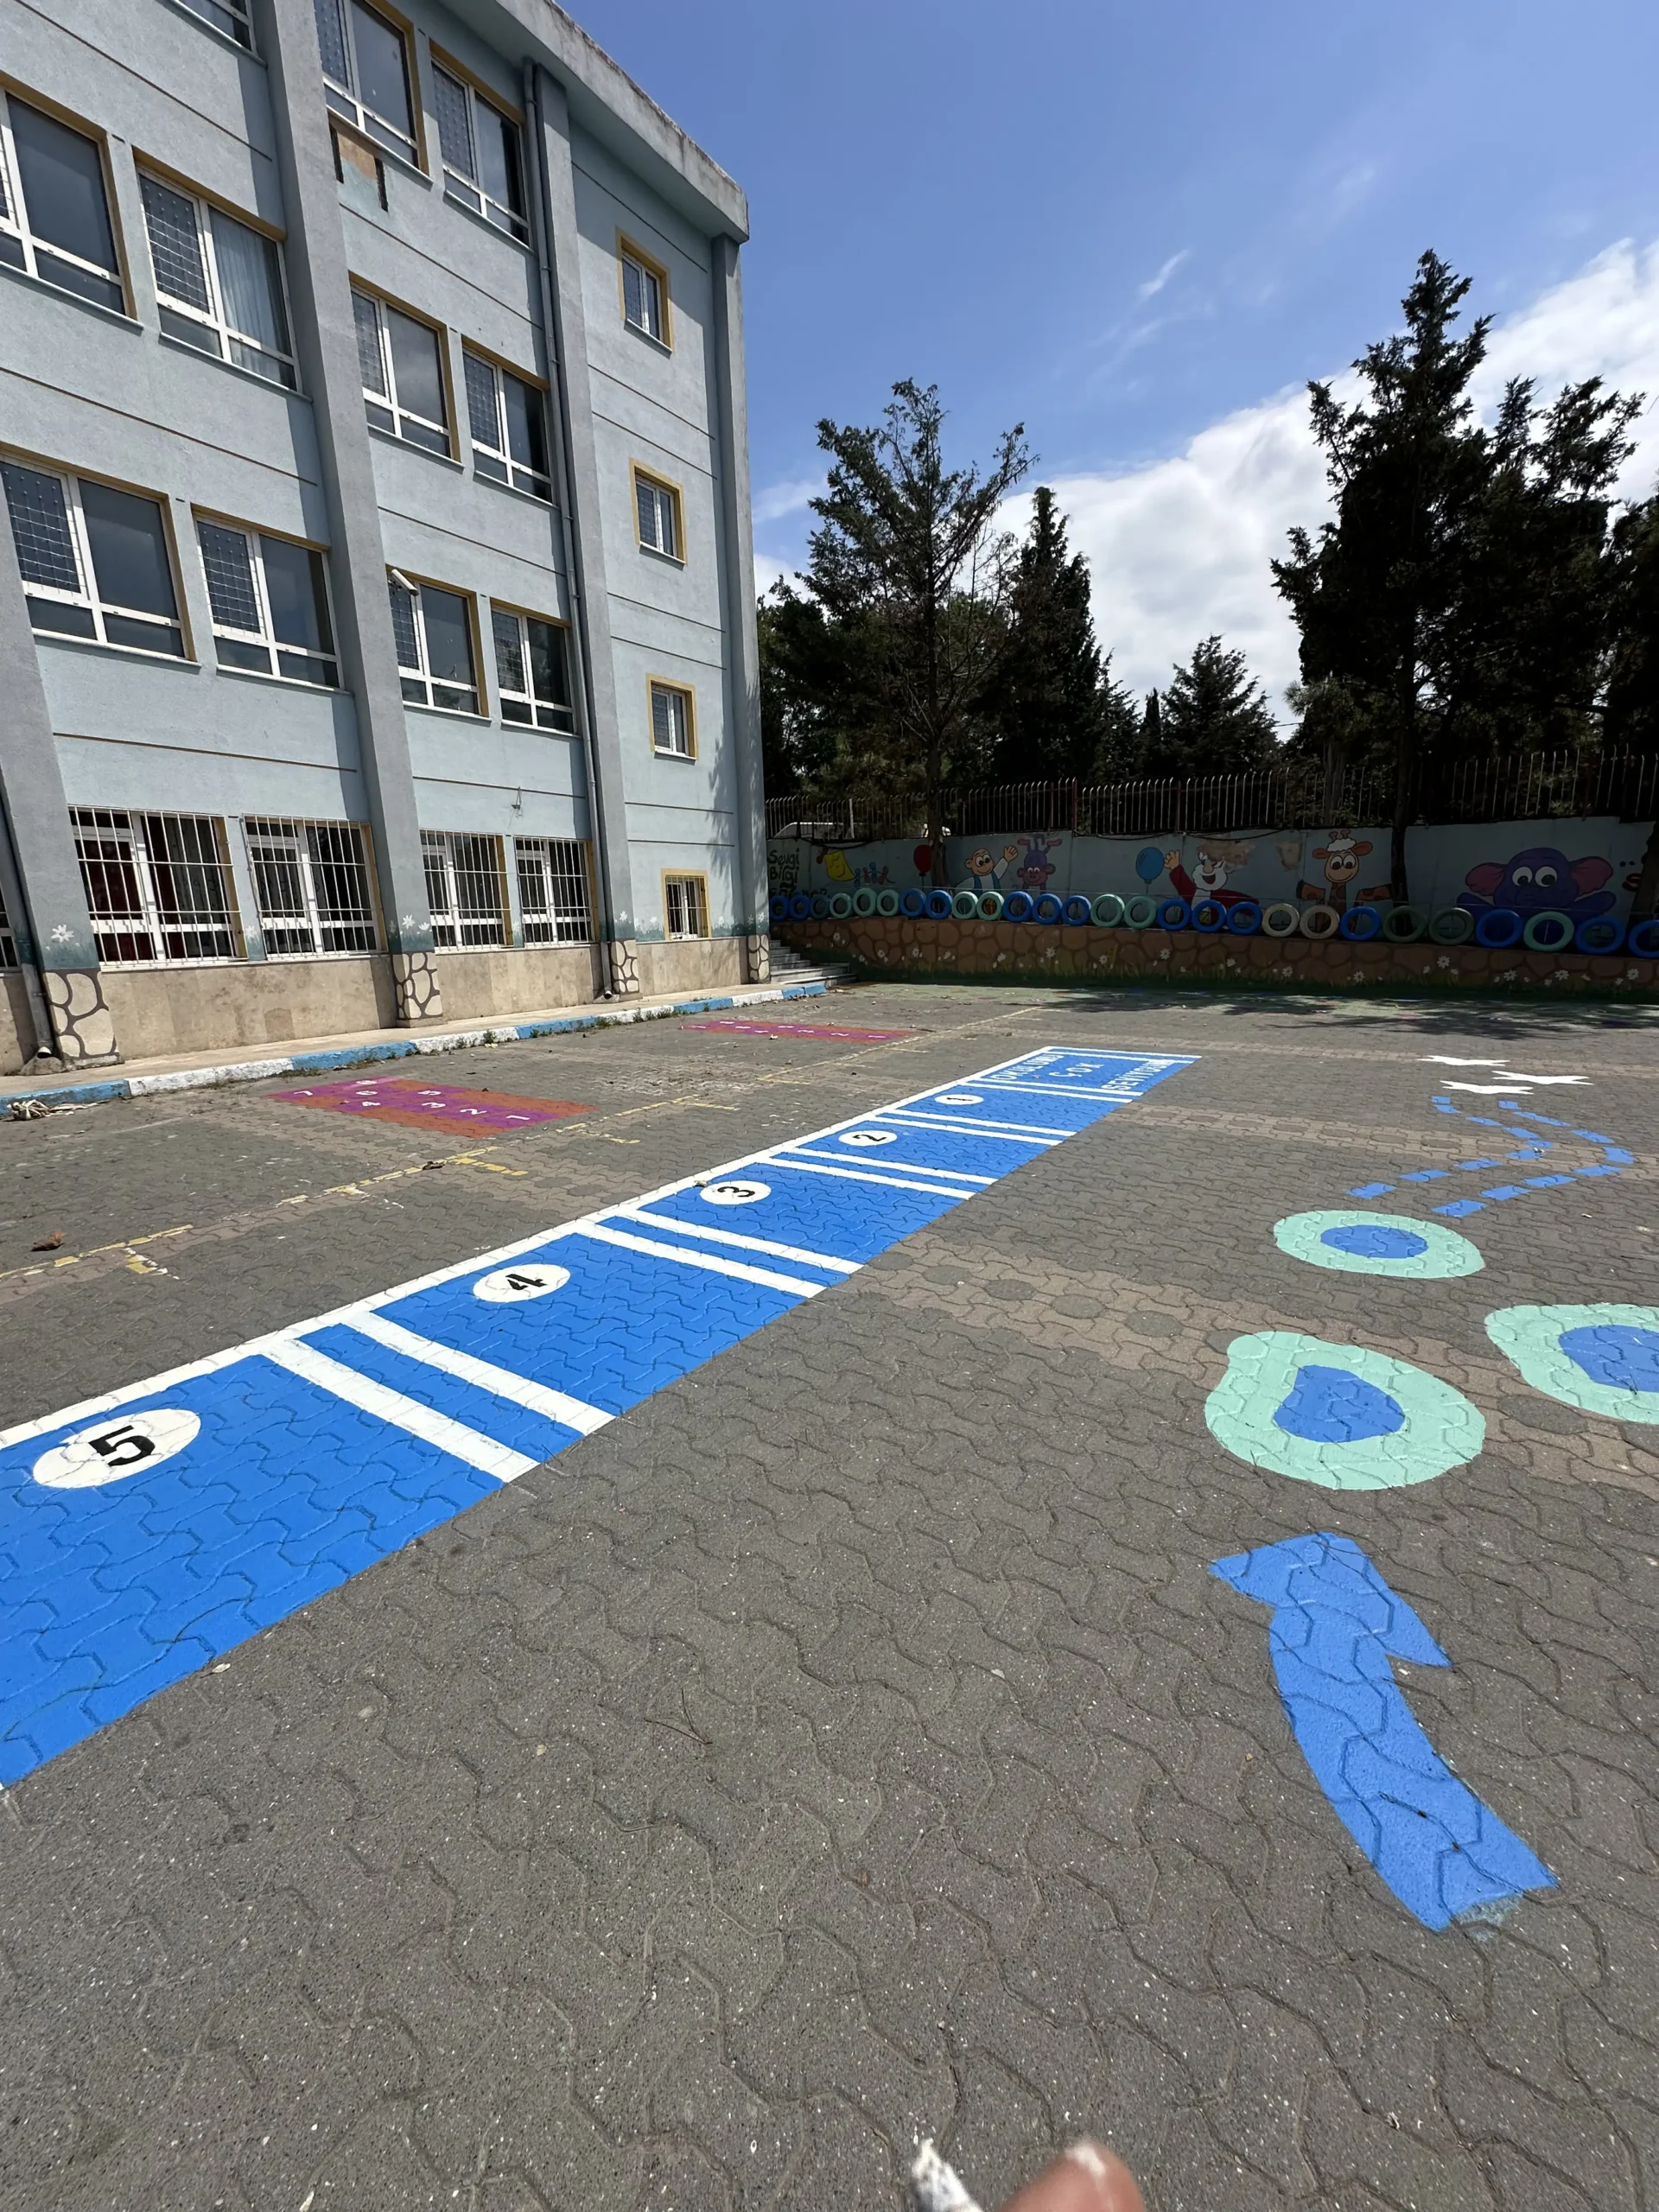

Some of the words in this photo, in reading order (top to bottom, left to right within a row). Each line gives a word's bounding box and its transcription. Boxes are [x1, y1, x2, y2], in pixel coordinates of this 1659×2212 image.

[767, 848, 799, 870] Sevgi
[769, 866, 799, 888] Bilgi
[852, 1133, 888, 1143] 2
[716, 1185, 756, 1198] 3
[505, 1273, 548, 1292] 4
[87, 1424, 156, 1467] 5
